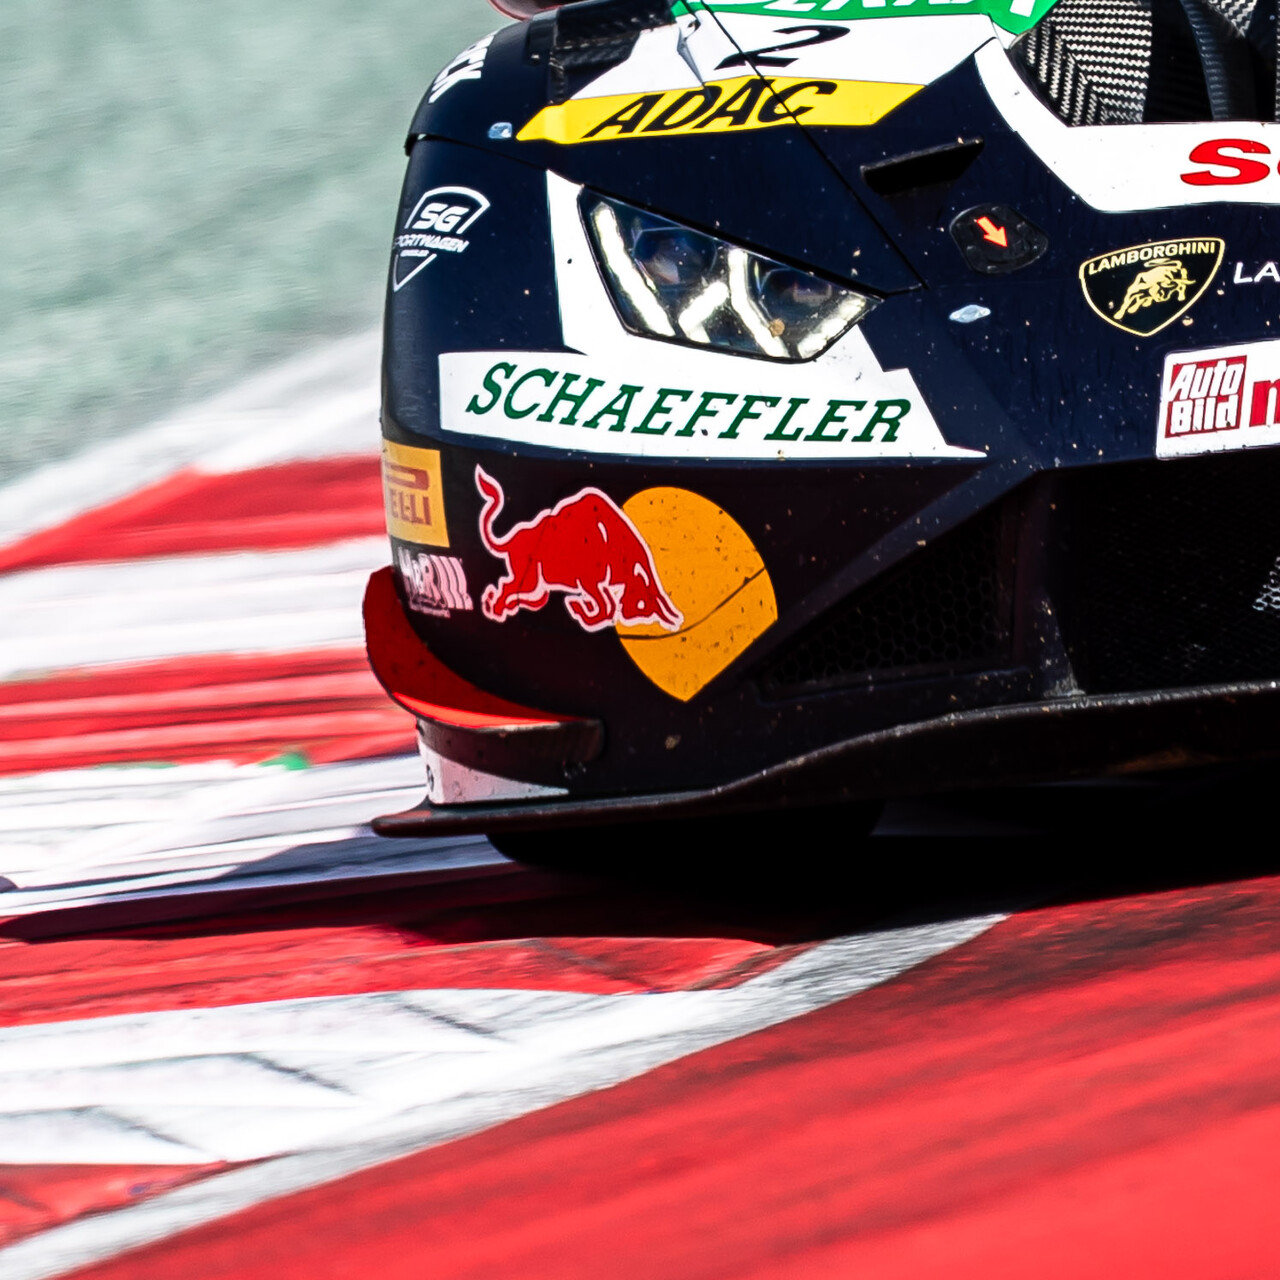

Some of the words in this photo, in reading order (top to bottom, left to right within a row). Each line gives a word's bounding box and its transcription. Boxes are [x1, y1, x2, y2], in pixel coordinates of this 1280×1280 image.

[715, 24, 850, 69] 2
[580, 80, 838, 139] ADAC
[412, 202, 470, 233] SG
[394, 233, 470, 253] PORTWAGEN
[1088, 241, 1216, 276] LAMBORGHINI
[1168, 362, 1245, 401] Auto
[466, 363, 911, 443] SCHAEFFLER
[1170, 393, 1239, 433] Bild
